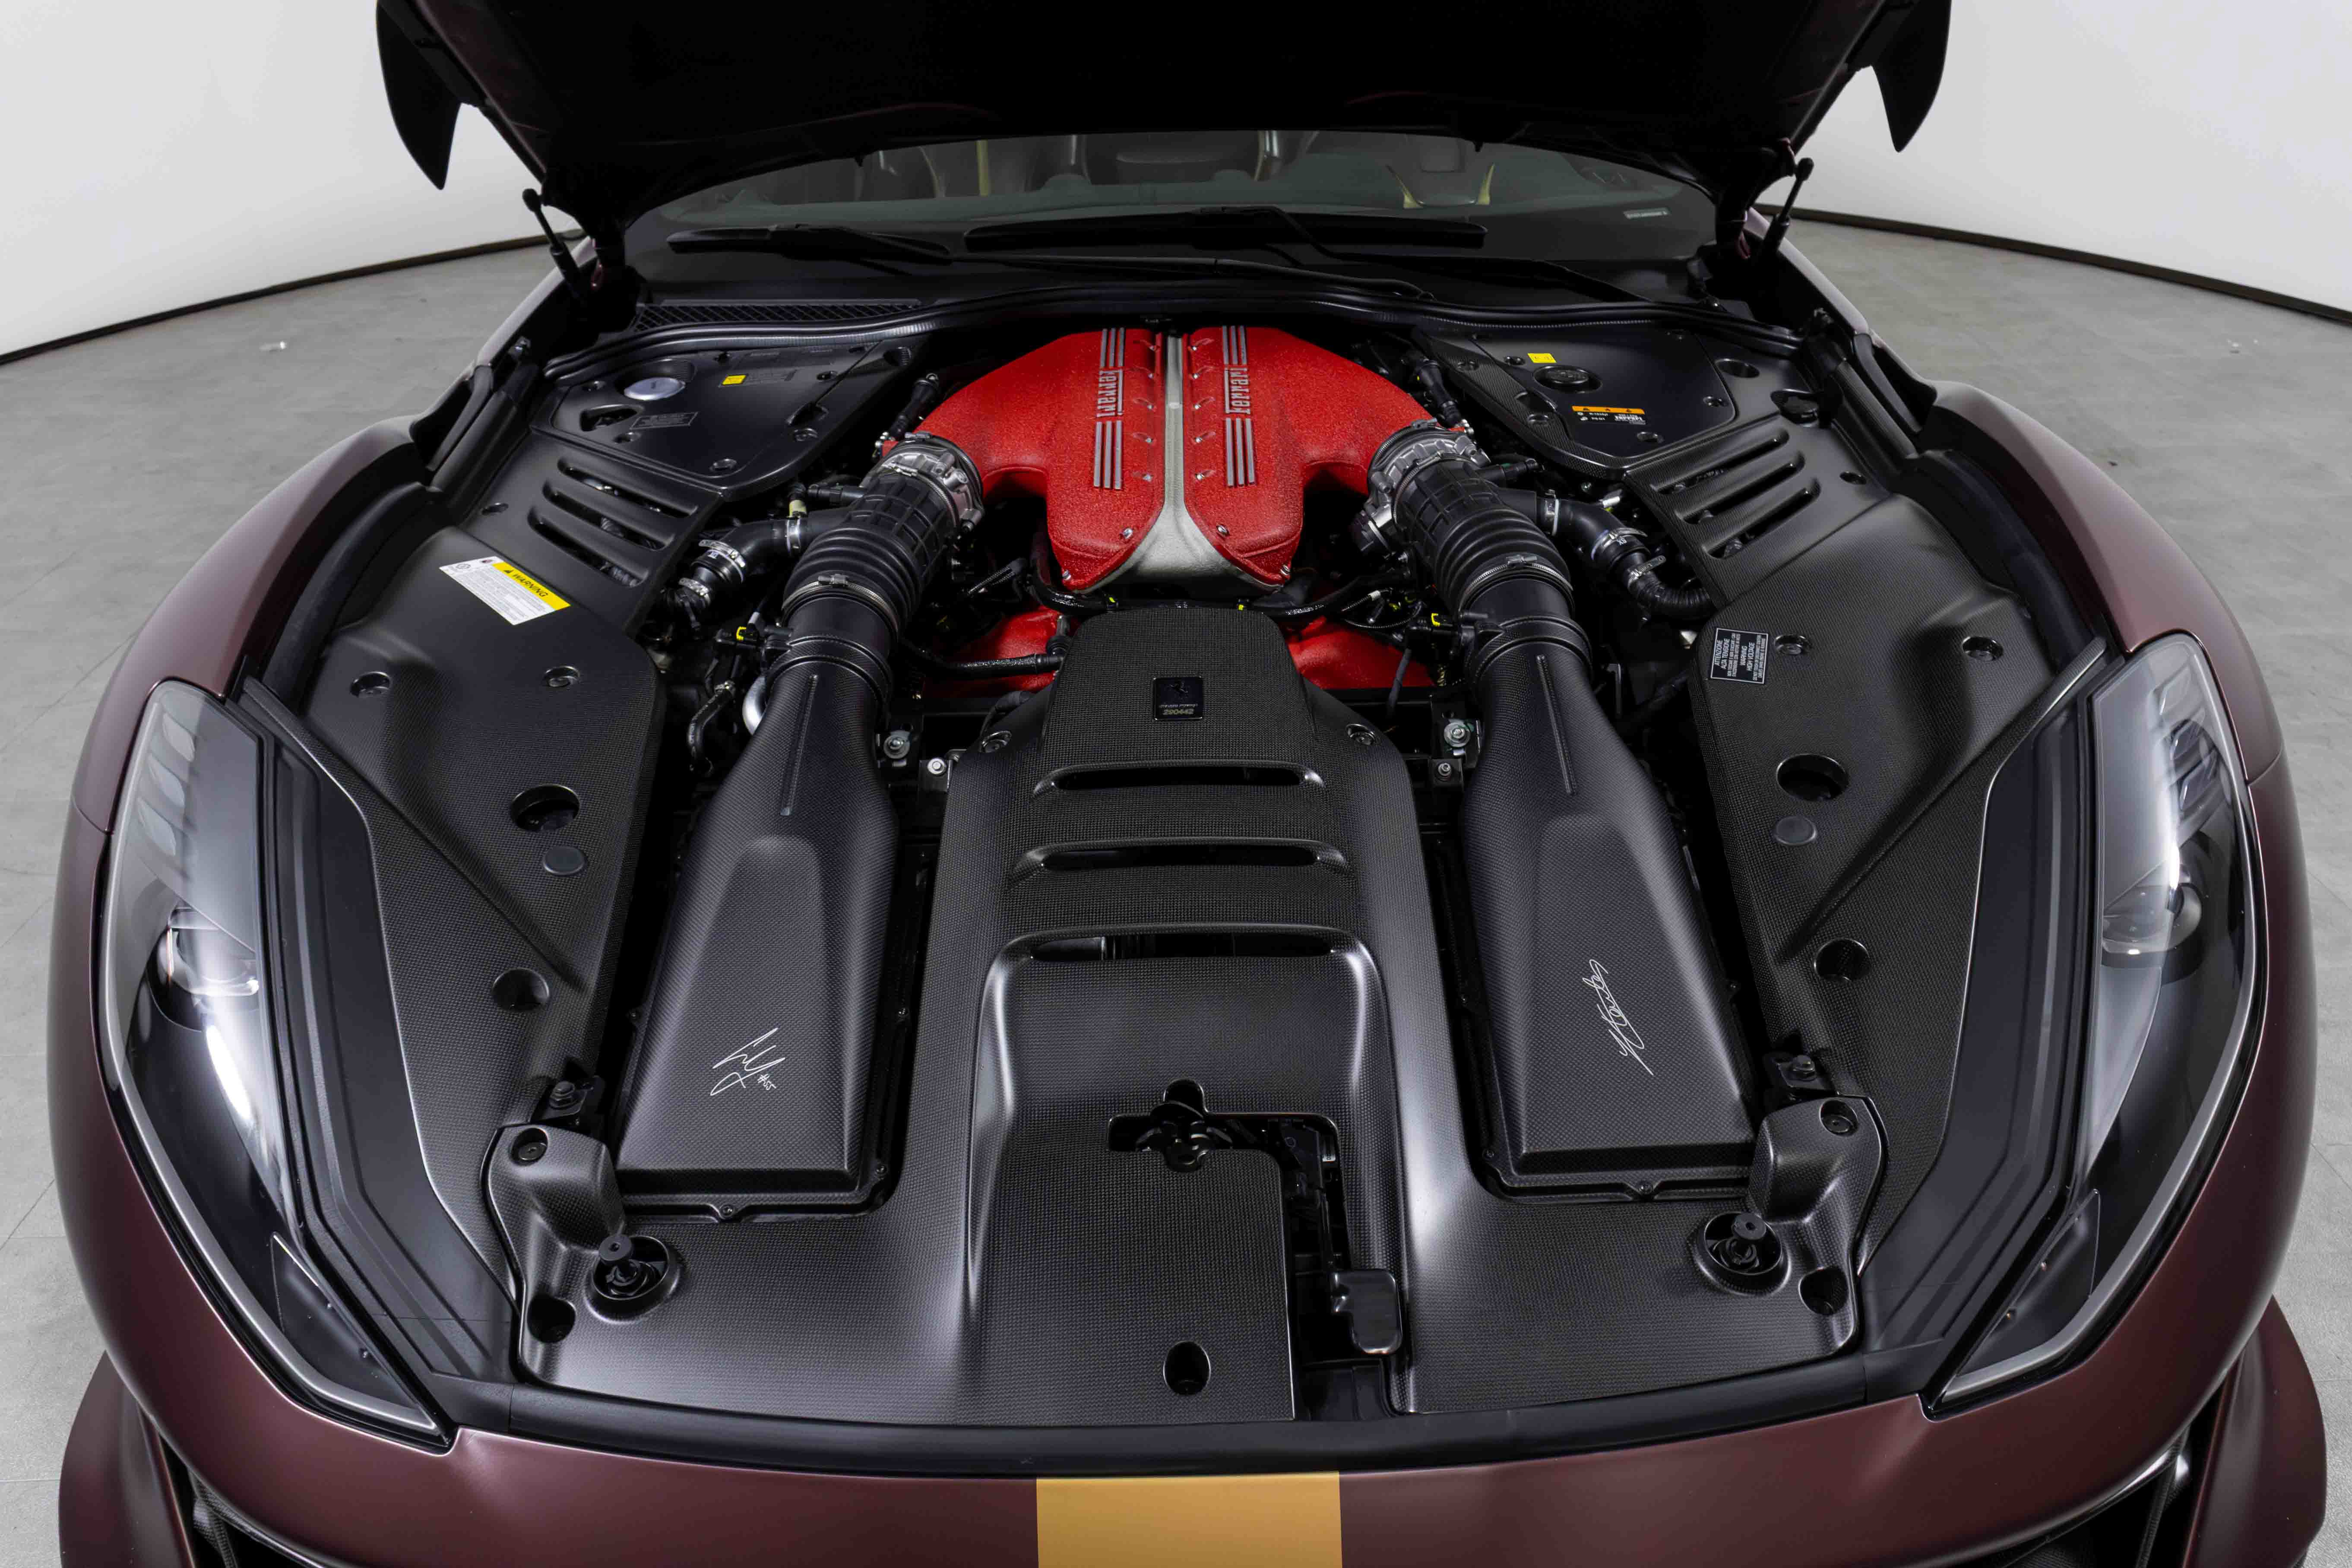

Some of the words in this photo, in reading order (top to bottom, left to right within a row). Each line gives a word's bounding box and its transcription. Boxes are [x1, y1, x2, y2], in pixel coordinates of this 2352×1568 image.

[512, 574, 548, 597] WARNING
[1715, 639, 1723, 666] ATTENZIONE
[1722, 638, 1730, 658] TENSIONE
